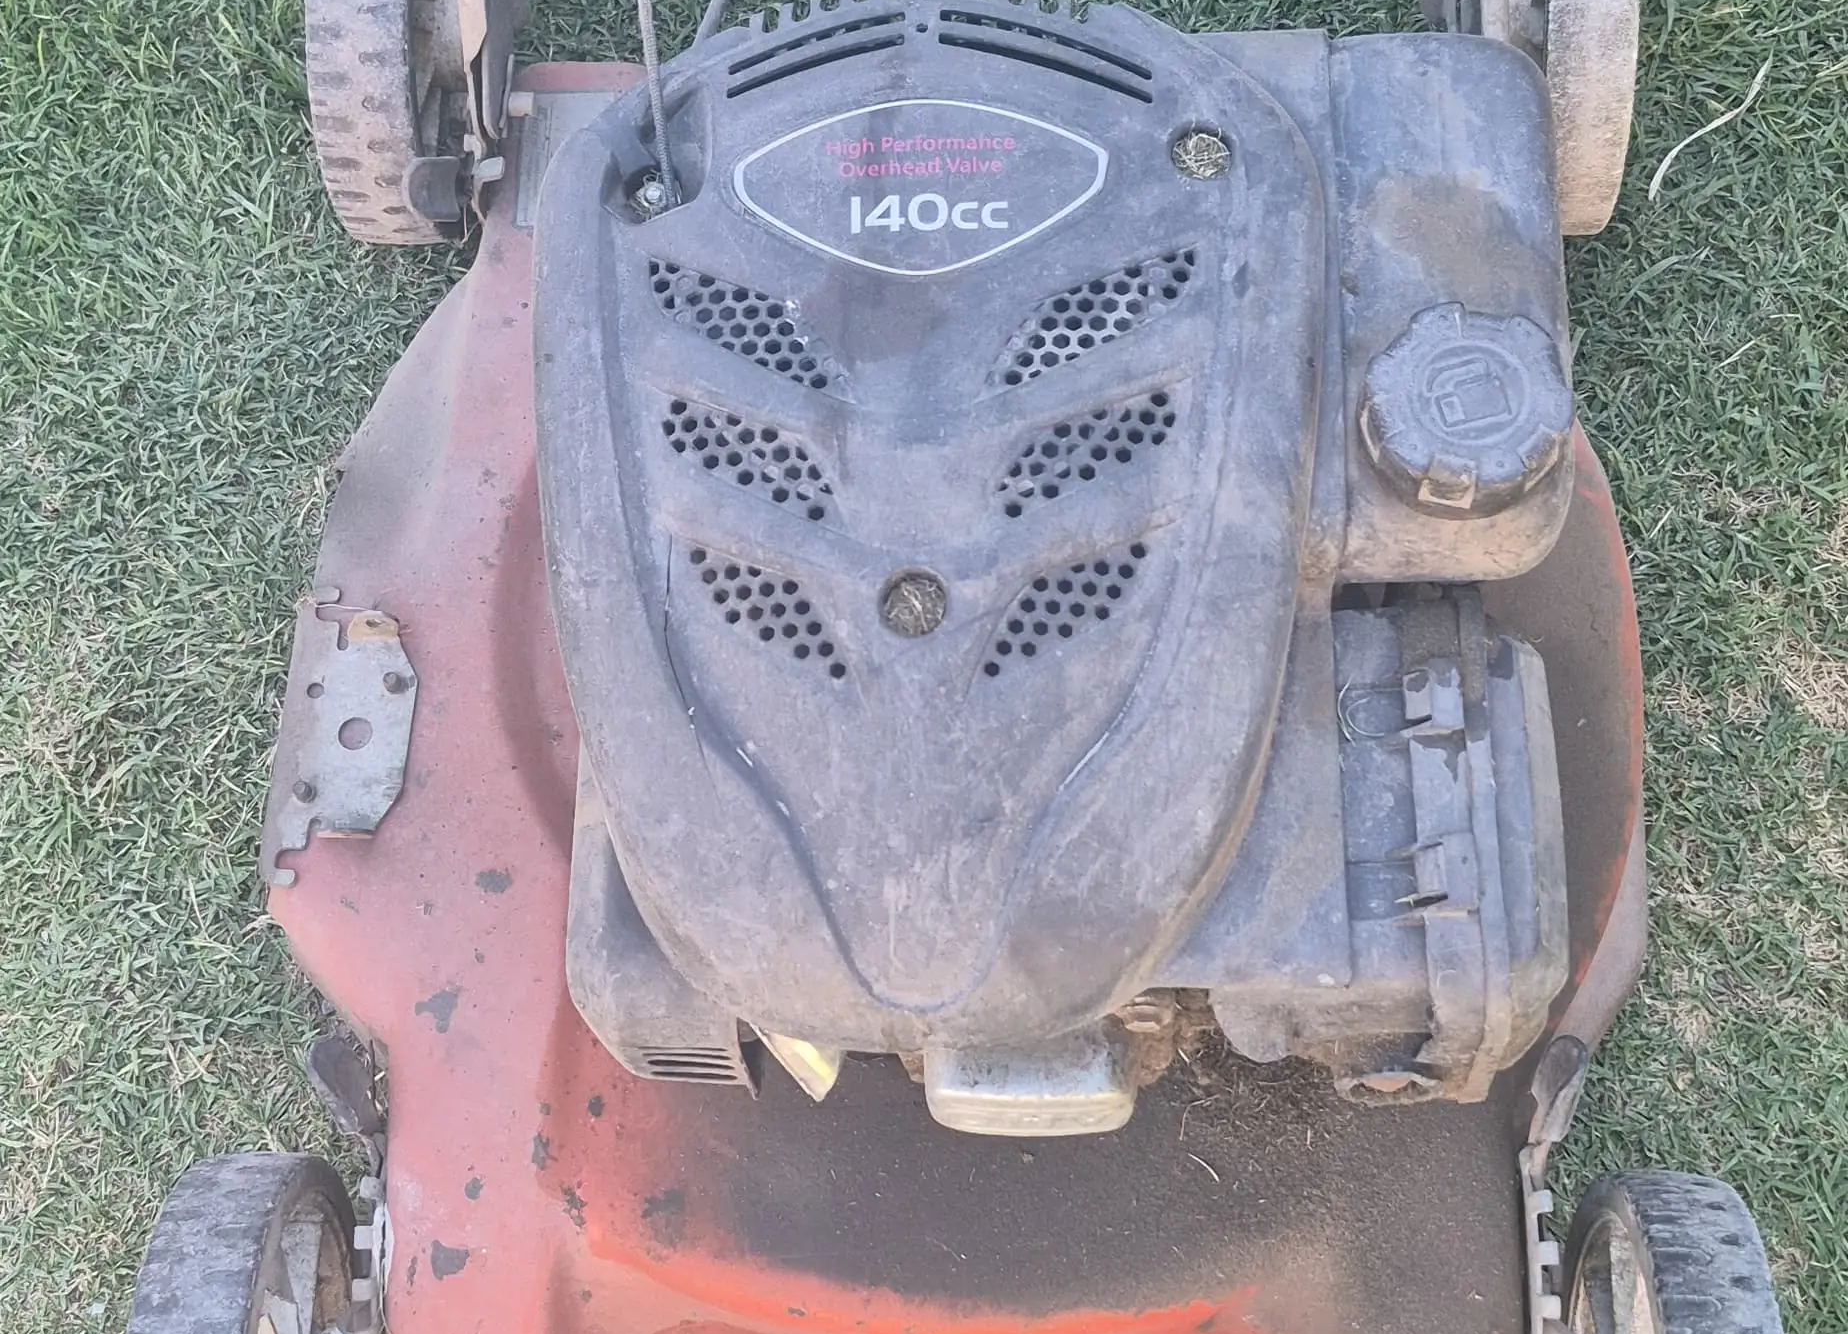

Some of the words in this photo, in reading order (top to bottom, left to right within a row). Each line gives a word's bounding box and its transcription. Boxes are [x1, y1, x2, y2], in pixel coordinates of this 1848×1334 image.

[825, 138, 875, 159] High
[881, 134, 1016, 153] Performance
[838, 157, 941, 178] Overhead
[946, 156, 1003, 174] Valve
[850, 193, 1009, 234] 140cc
